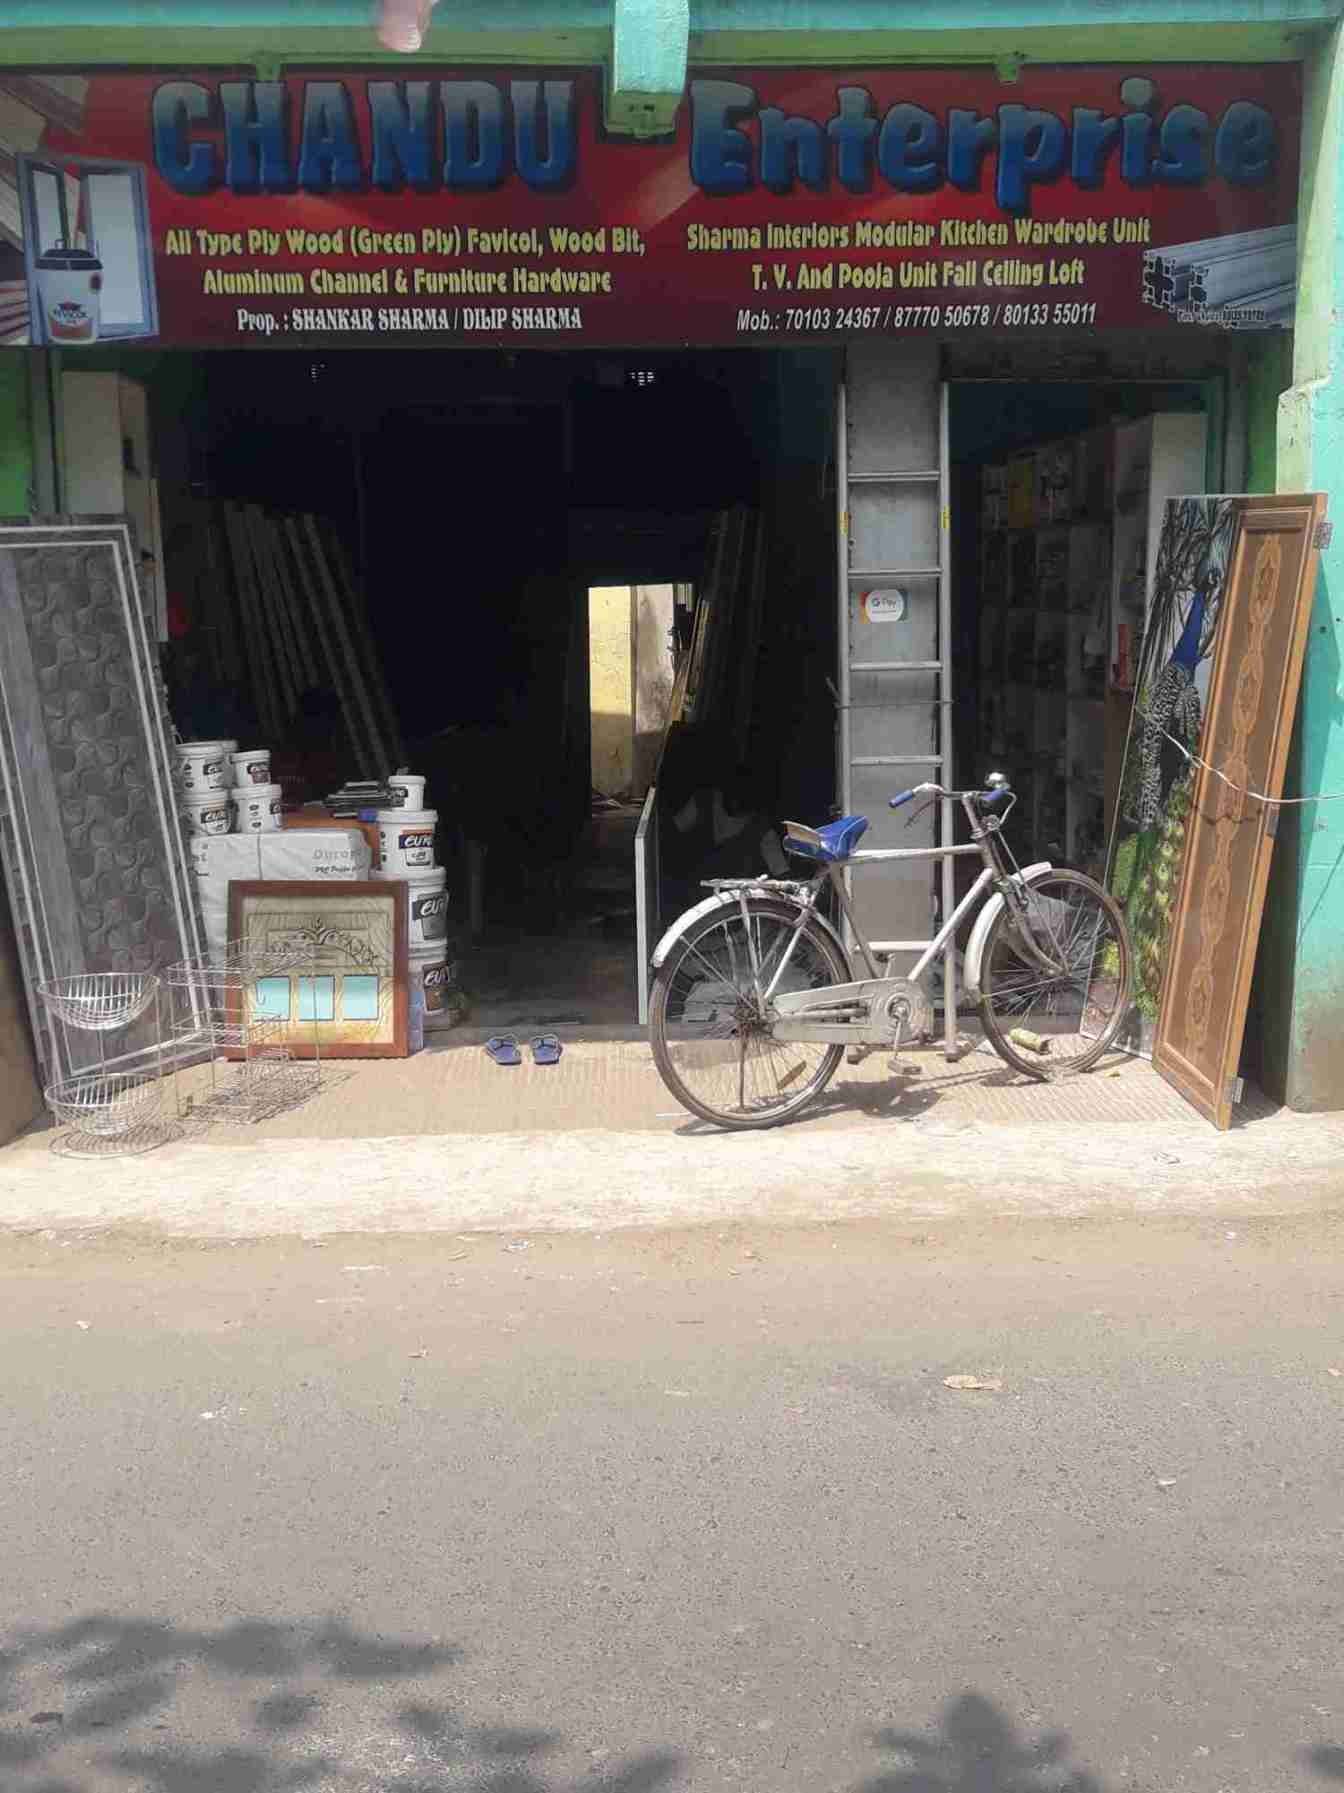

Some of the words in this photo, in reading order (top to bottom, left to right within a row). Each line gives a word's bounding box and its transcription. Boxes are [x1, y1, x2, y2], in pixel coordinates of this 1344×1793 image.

[150, 79, 578, 195] CHANDU
[687, 77, 1279, 211] Enterprise
[166, 229, 192, 255] All
[197, 229, 242, 256] Type
[249, 229, 281, 256] Ply
[286, 228, 344, 255] Wood
[350, 225, 417, 257] (Green
[422, 225, 461, 257] Ply)
[467, 227, 544, 258] Favicol,
[549, 226, 606, 253] Wood
[611, 225, 646, 256] Bit,
[687, 222, 761, 250] Sharma
[767, 222, 850, 249] Interiors
[854, 220, 936, 248] Modular
[940, 219, 1009, 246] Kitchen
[1014, 217, 1108, 244] Wardrobe
[1113, 216, 1150, 243] Unit
[203, 269, 305, 294] Aluminum
[310, 269, 389, 294] Channel
[394, 269, 409, 294] &
[414, 268, 507, 294] Furniture
[513, 268, 612, 293] Hardware
[797, 262, 833, 290] And
[838, 261, 893, 289] Pooja
[899, 261, 938, 288] Unit
[942, 260, 977, 287] Fall
[982, 258, 1044, 287] Ceiling
[1049, 257, 1085, 286] Loft
[292, 307, 375, 331] SHANKAR
[378, 307, 449, 330] SHARMA
[463, 306, 507, 330] DILIP
[511, 306, 583, 330] SHARMA
[786, 308, 830, 330] 70103
[835, 307, 881, 330] 24367
[894, 305, 940, 328] 87770
[944, 305, 989, 327] 50678
[1003, 304, 1048, 326] 80133
[1053, 302, 1097, 325] 55011
